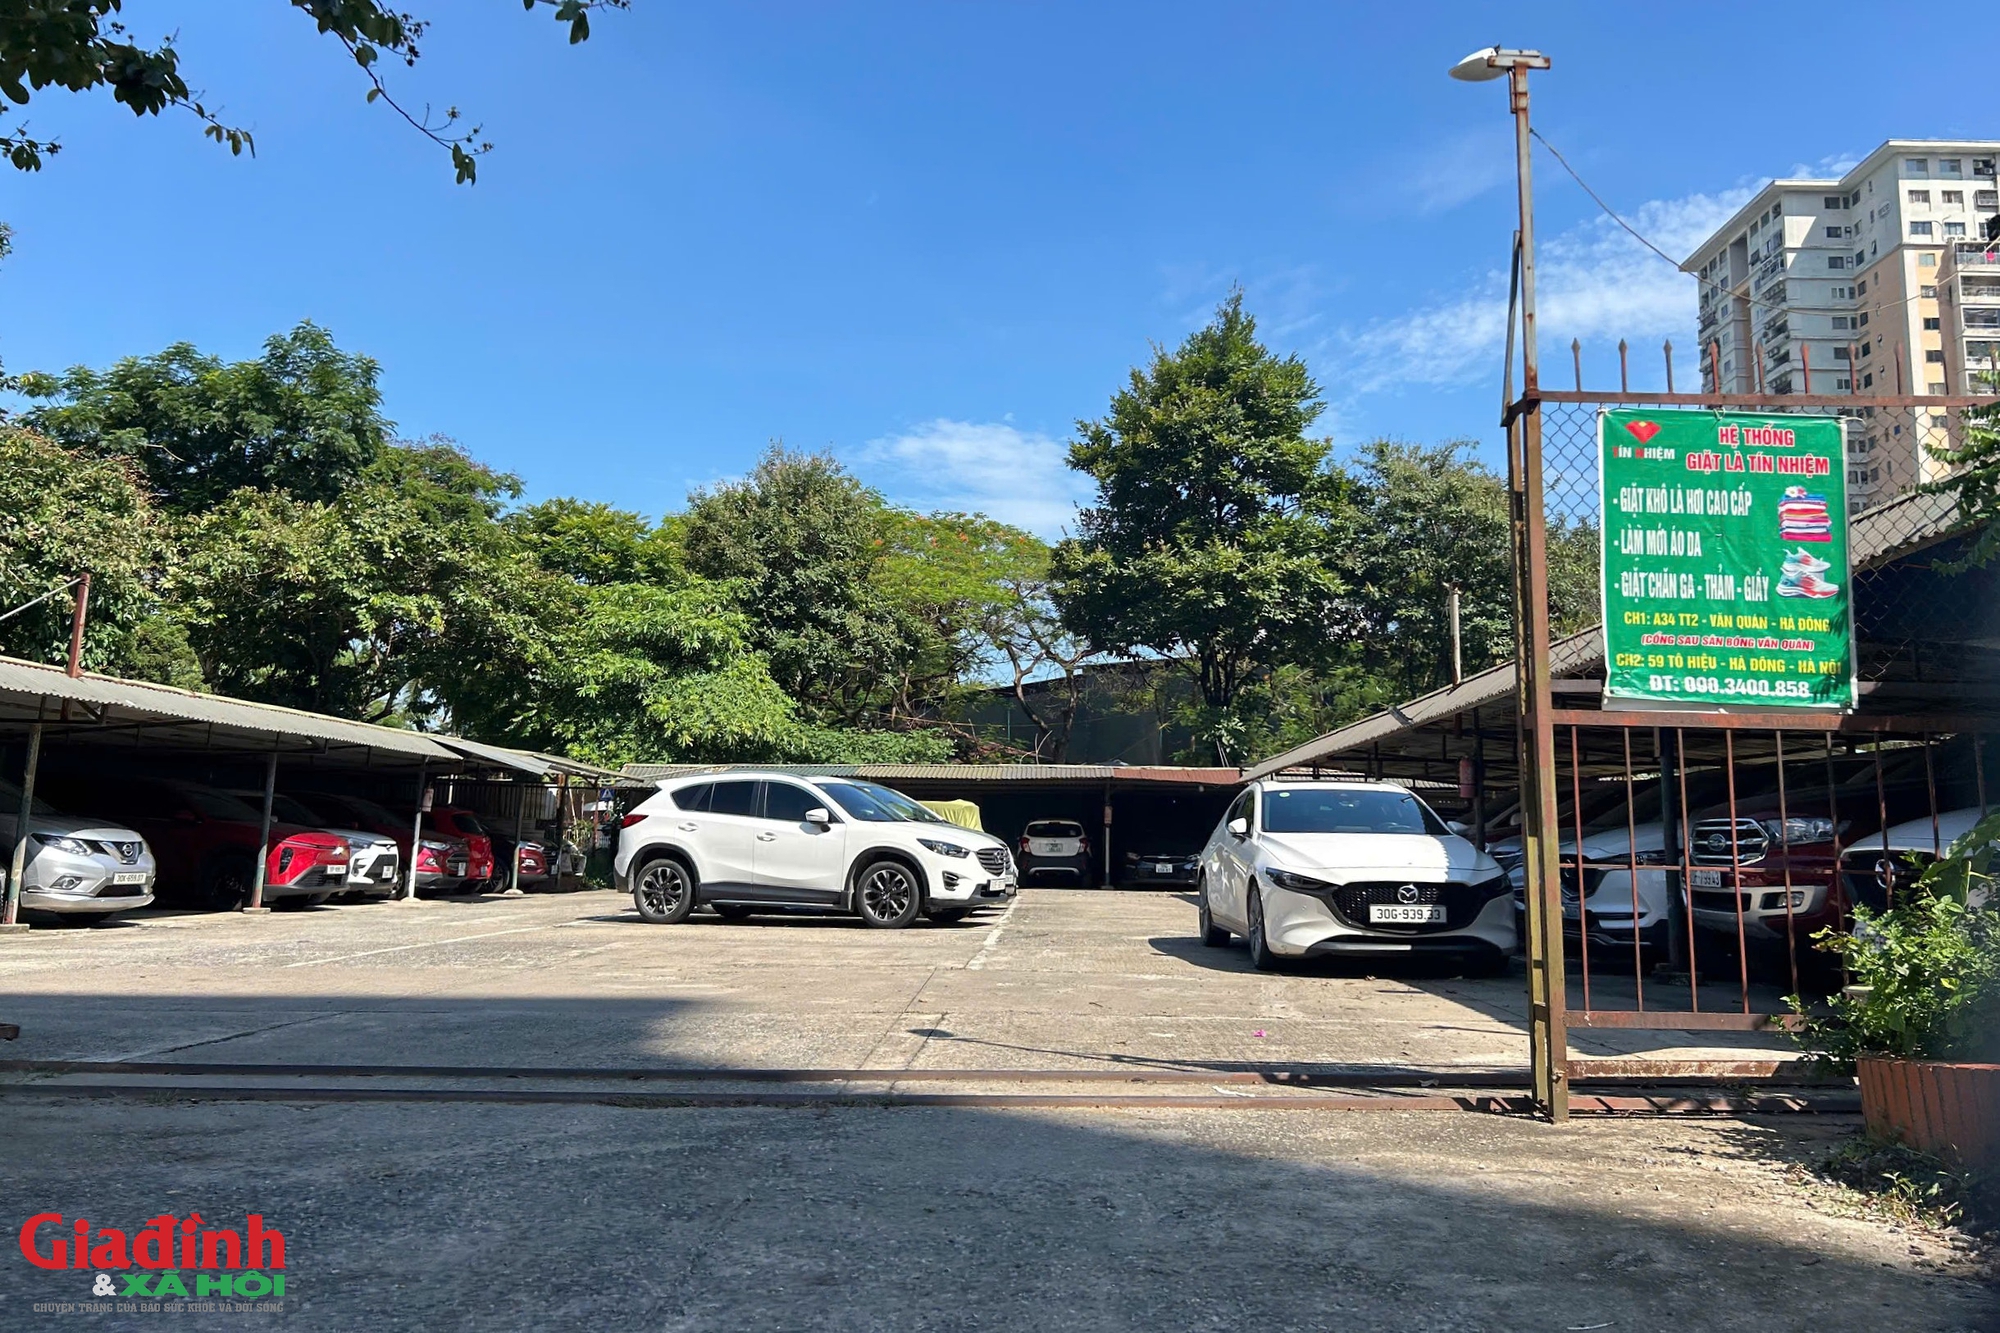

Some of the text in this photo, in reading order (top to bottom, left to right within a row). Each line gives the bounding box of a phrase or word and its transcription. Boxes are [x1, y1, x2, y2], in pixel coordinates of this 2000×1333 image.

[1718, 423, 1795, 449] HỆ THỐNG
[1612, 445, 1675, 461] TÍN NHIỆM
[1686, 450, 1830, 478] GIẶT LÀ TÍN NHIỆM
[1620, 482, 1752, 518] GIẶT KHÔ LÀ HƠI CAO CẤP
[1621, 522, 1702, 557] LÀM MỚI ÁO DA
[1621, 567, 1647, 603] GIẶT
[1648, 567, 1677, 599] CHĂN
[1679, 573, 1695, 599] GA
[1704, 563, 1735, 600] THẢM
[1624, 611, 1650, 625] CH1:
[1653, 612, 1675, 626] A34
[1678, 613, 1699, 626] TT2
[1709, 612, 1733, 628] VĂN
[1736, 614, 1768, 629] QUÁN
[1780, 614, 1795, 631] HÀ
[1798, 616, 1830, 632] ĐÔNG
[1677, 634, 1699, 646] SAU
[1701, 634, 1724, 647] SÂN
[1725, 635, 1755, 648] BÓNG
[1757, 636, 1779, 649] VĂN
[1616, 653, 1644, 667] CH2:
[1648, 654, 1664, 668] 59
[1667, 653, 1684, 668] TÔ
[1687, 653, 1717, 672] HIỆU
[1729, 655, 1746, 670] HÀ
[1749, 656, 1786, 672] ĐÔNG
[1798, 657, 1816, 674] HÀ
[1376, 908, 1441, 920] 30G-939.33
